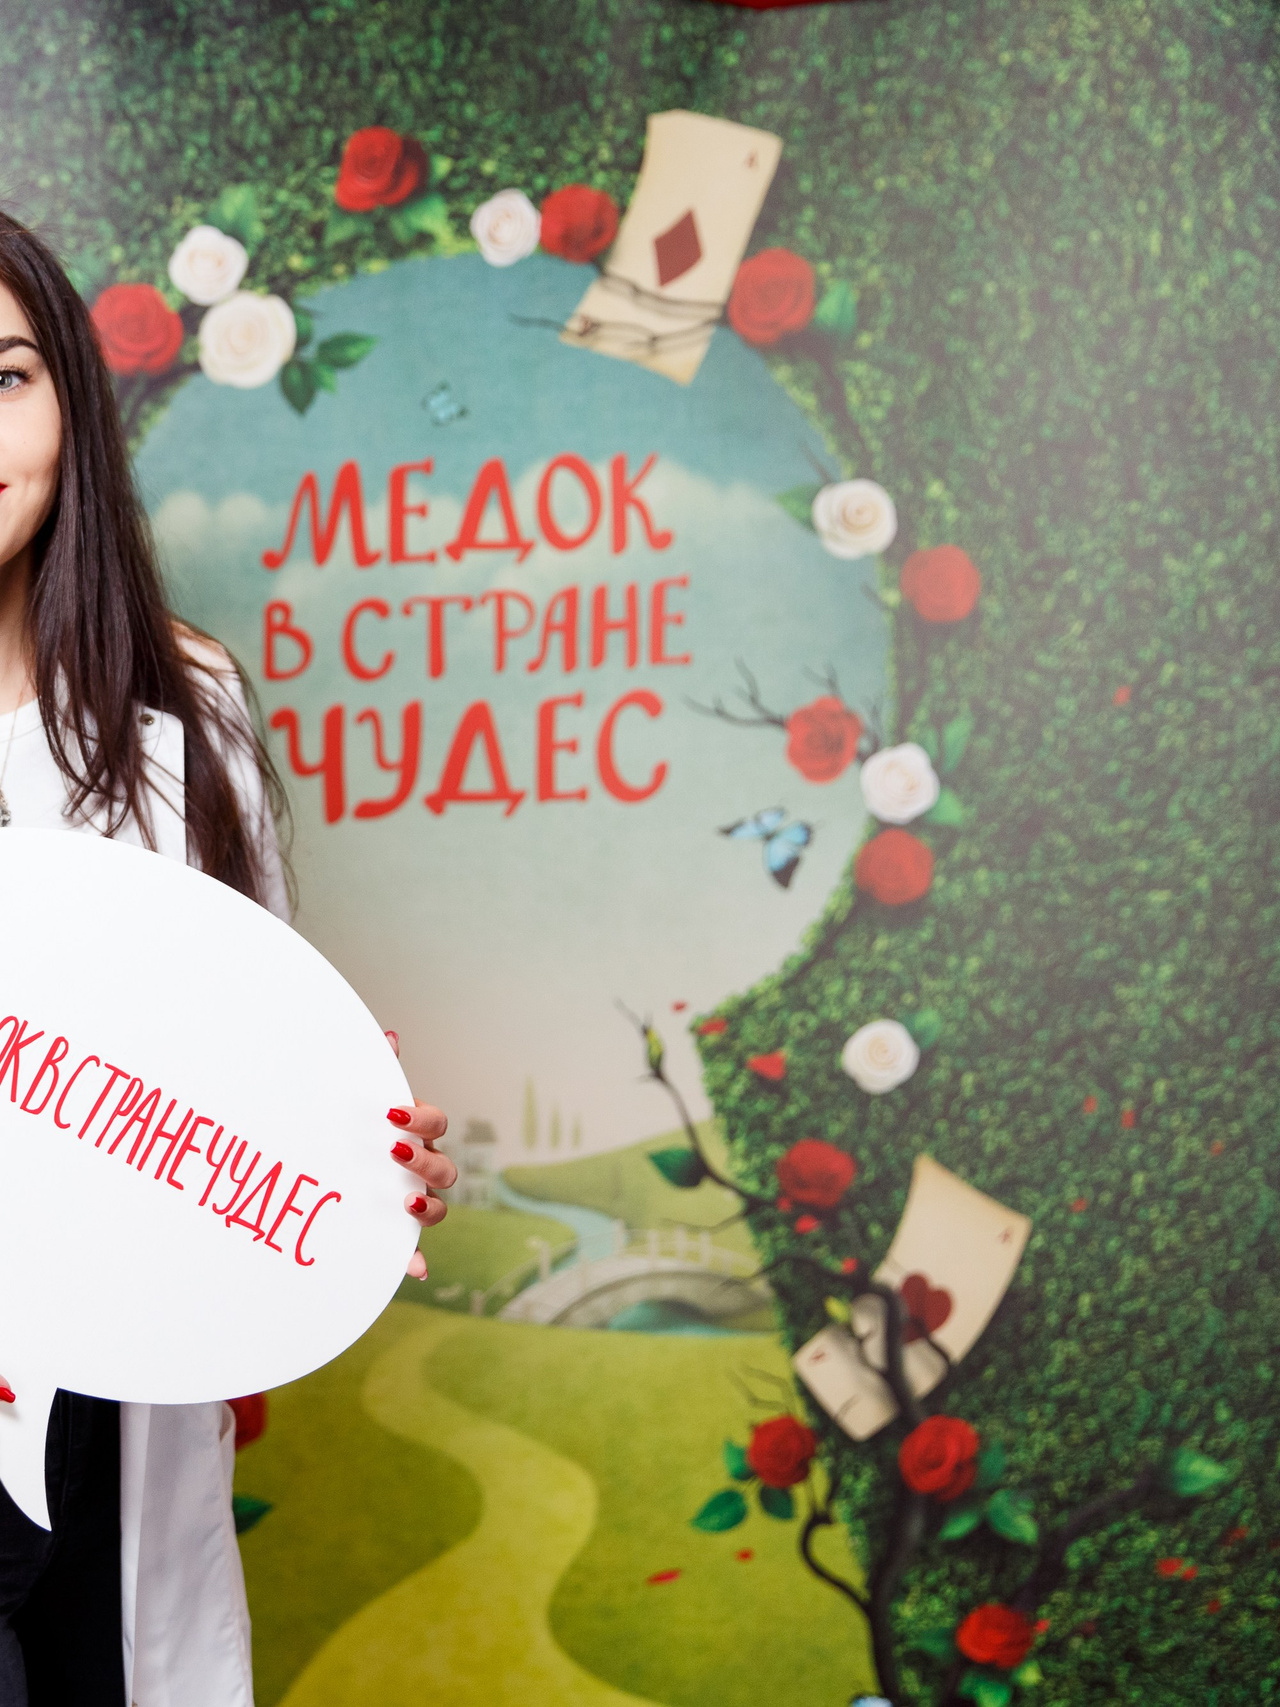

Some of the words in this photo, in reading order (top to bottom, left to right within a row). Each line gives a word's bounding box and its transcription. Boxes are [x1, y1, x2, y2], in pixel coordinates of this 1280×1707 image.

[260, 452, 674, 571] МЕДОК
[263, 600, 314, 682] В
[341, 575, 692, 683] СТРАНЕ
[268, 689, 669, 826] ЧУДЕС
